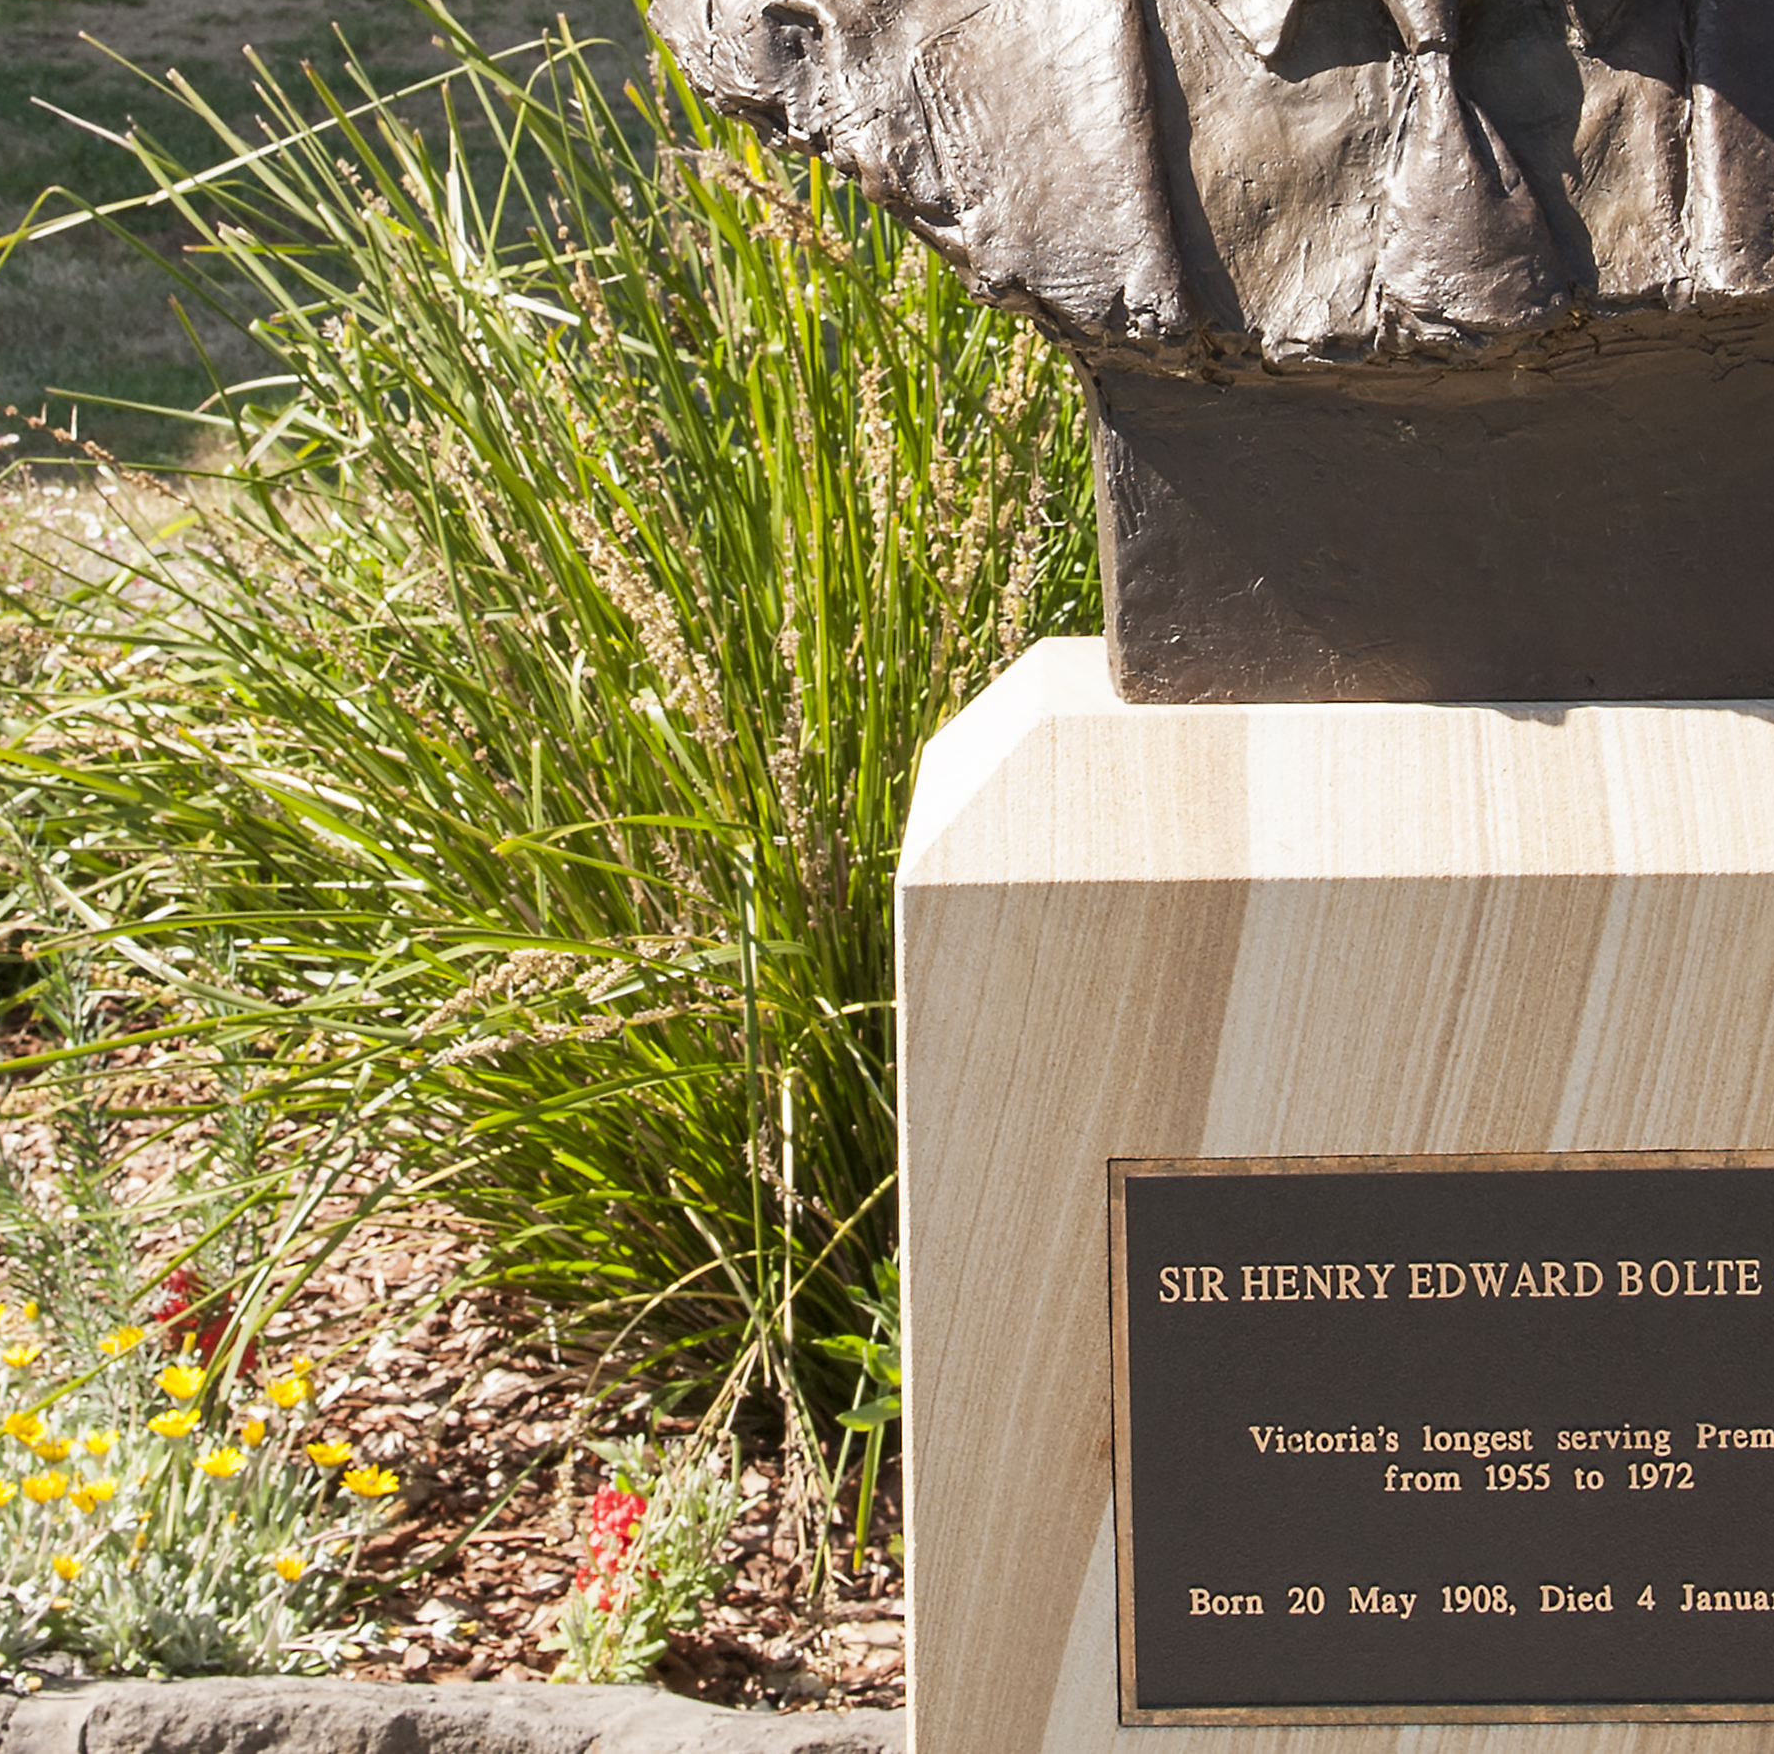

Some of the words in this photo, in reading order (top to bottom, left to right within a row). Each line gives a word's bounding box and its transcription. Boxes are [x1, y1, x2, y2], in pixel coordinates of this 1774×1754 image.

[1159, 1266, 1229, 1303] SIR
[1240, 1263, 1396, 1302] HENRY
[1407, 1261, 1604, 1299] EDWARD
[1616, 1259, 1763, 1297] BOLTE
[1248, 1424, 1400, 1454] Victoria's
[1422, 1424, 1534, 1459] longest
[1557, 1423, 1672, 1457] serving
[1383, 1464, 1463, 1492] from
[1485, 1462, 1551, 1492] 1955
[1574, 1467, 1605, 1491] to
[1627, 1461, 1695, 1490] 1972
[1188, 1587, 1265, 1616] Born
[1287, 1586, 1326, 1615] 20
[1348, 1586, 1418, 1620] May
[1441, 1584, 1517, 1618] 1908,
[1539, 1584, 1614, 1613] Died
[1636, 1584, 1657, 1611] 4
